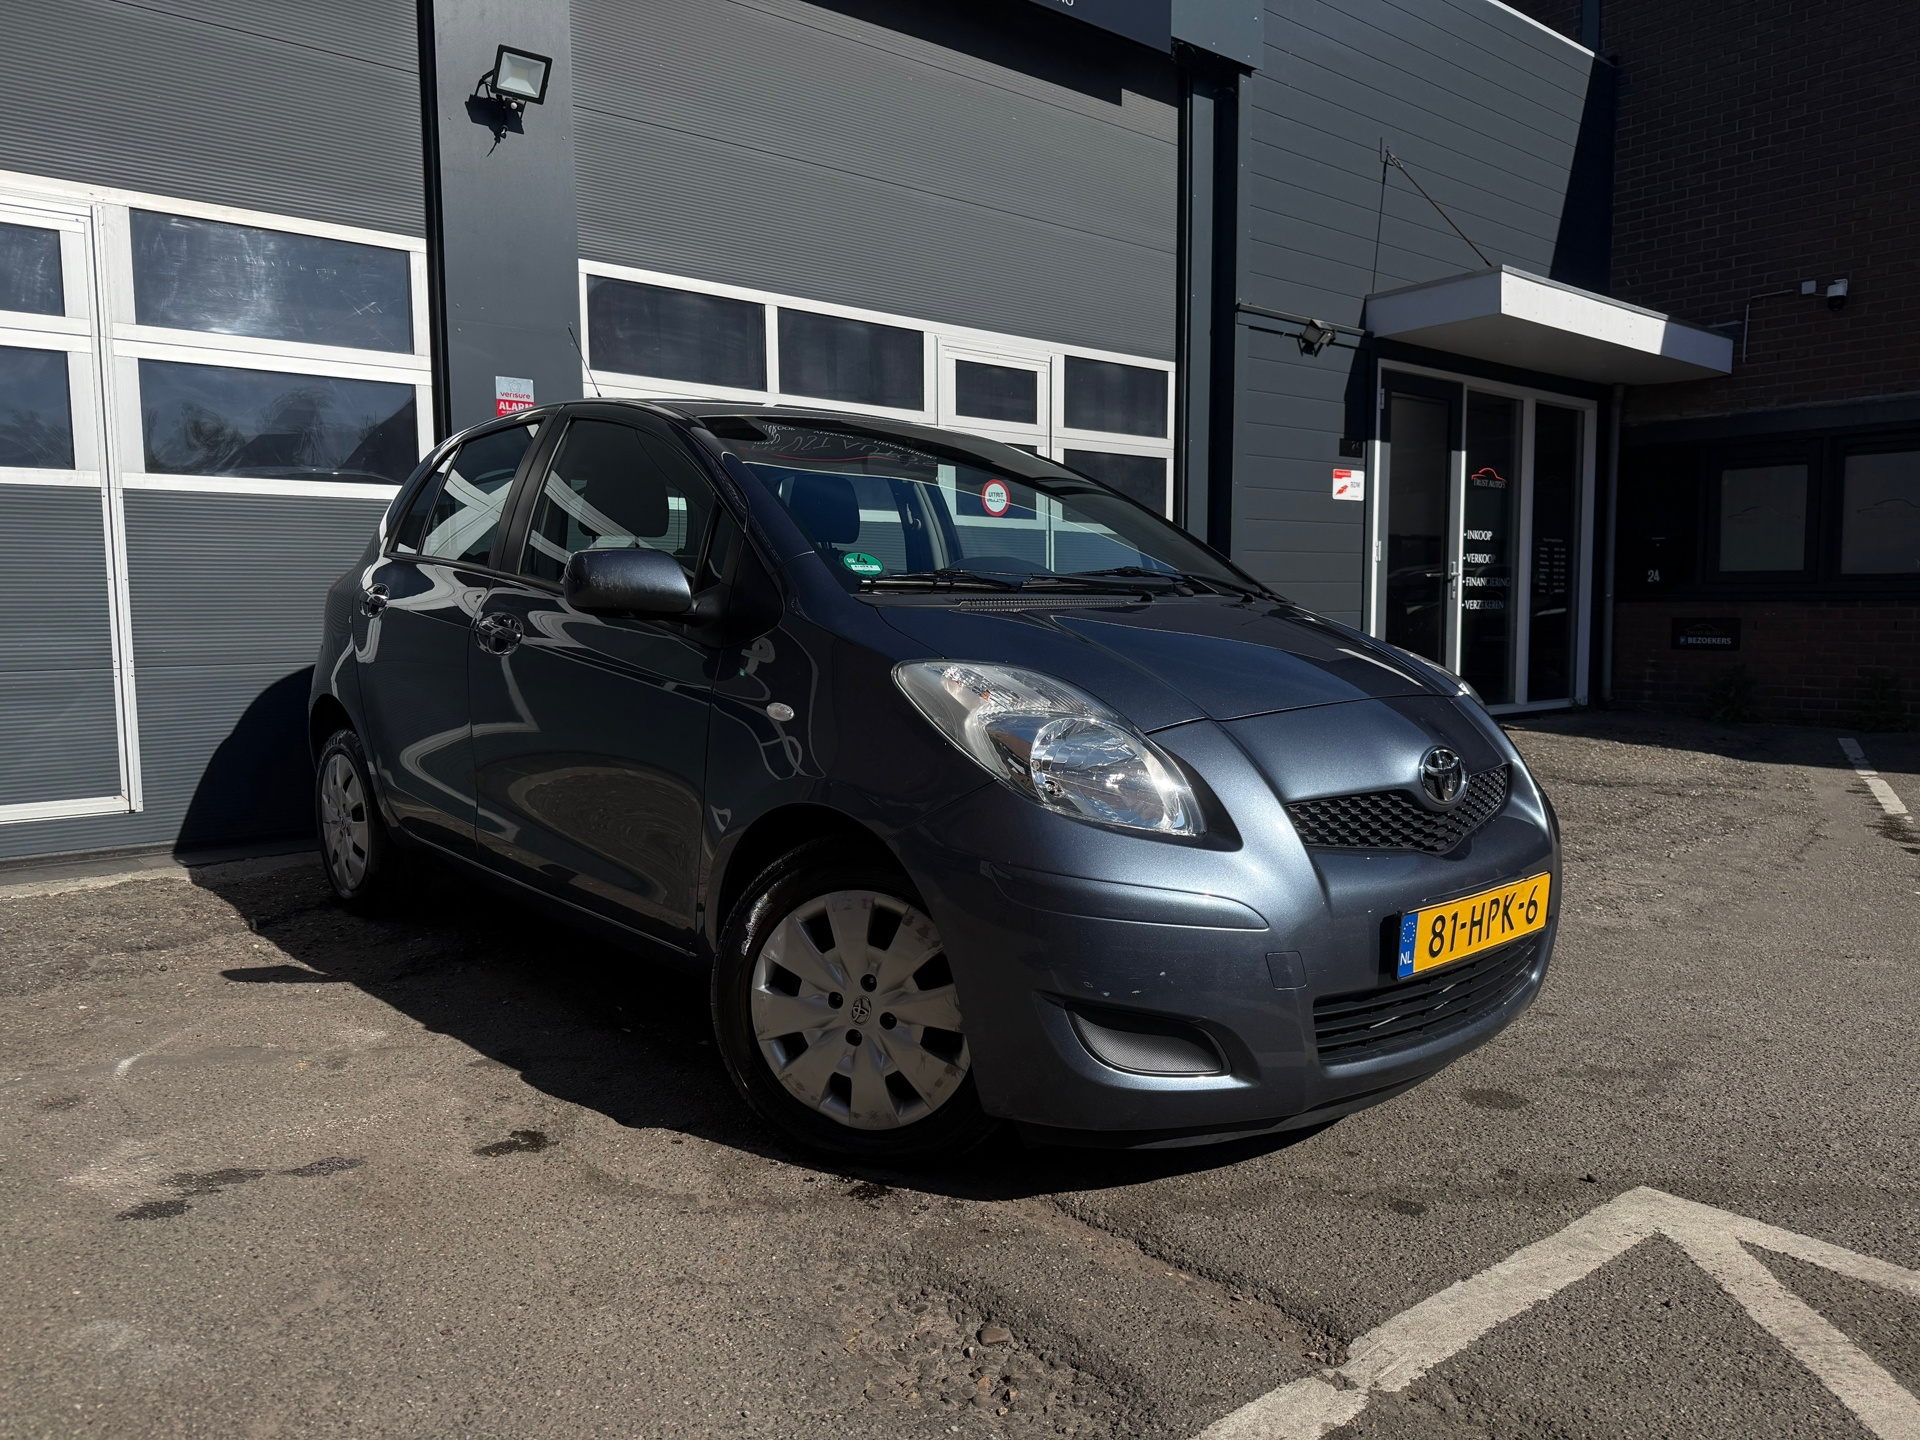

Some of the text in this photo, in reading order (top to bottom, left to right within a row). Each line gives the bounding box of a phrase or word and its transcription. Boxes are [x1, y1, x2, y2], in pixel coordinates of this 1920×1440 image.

[1474, 478, 1488, 487] TRUST
[1467, 530, 1493, 541] INKOOP
[857, 554, 867, 564] 4
[1466, 553, 1496, 564] VERKOOP
[1647, 569, 1660, 582] 24
[1466, 576, 1511, 587] FINANCIERING
[1465, 599, 1504, 610] VERZEKEREN
[1687, 636, 1732, 644] BEZOEKERS
[1428, 885, 1539, 958] 81-HPK-6
[1400, 952, 1412, 966] NL
